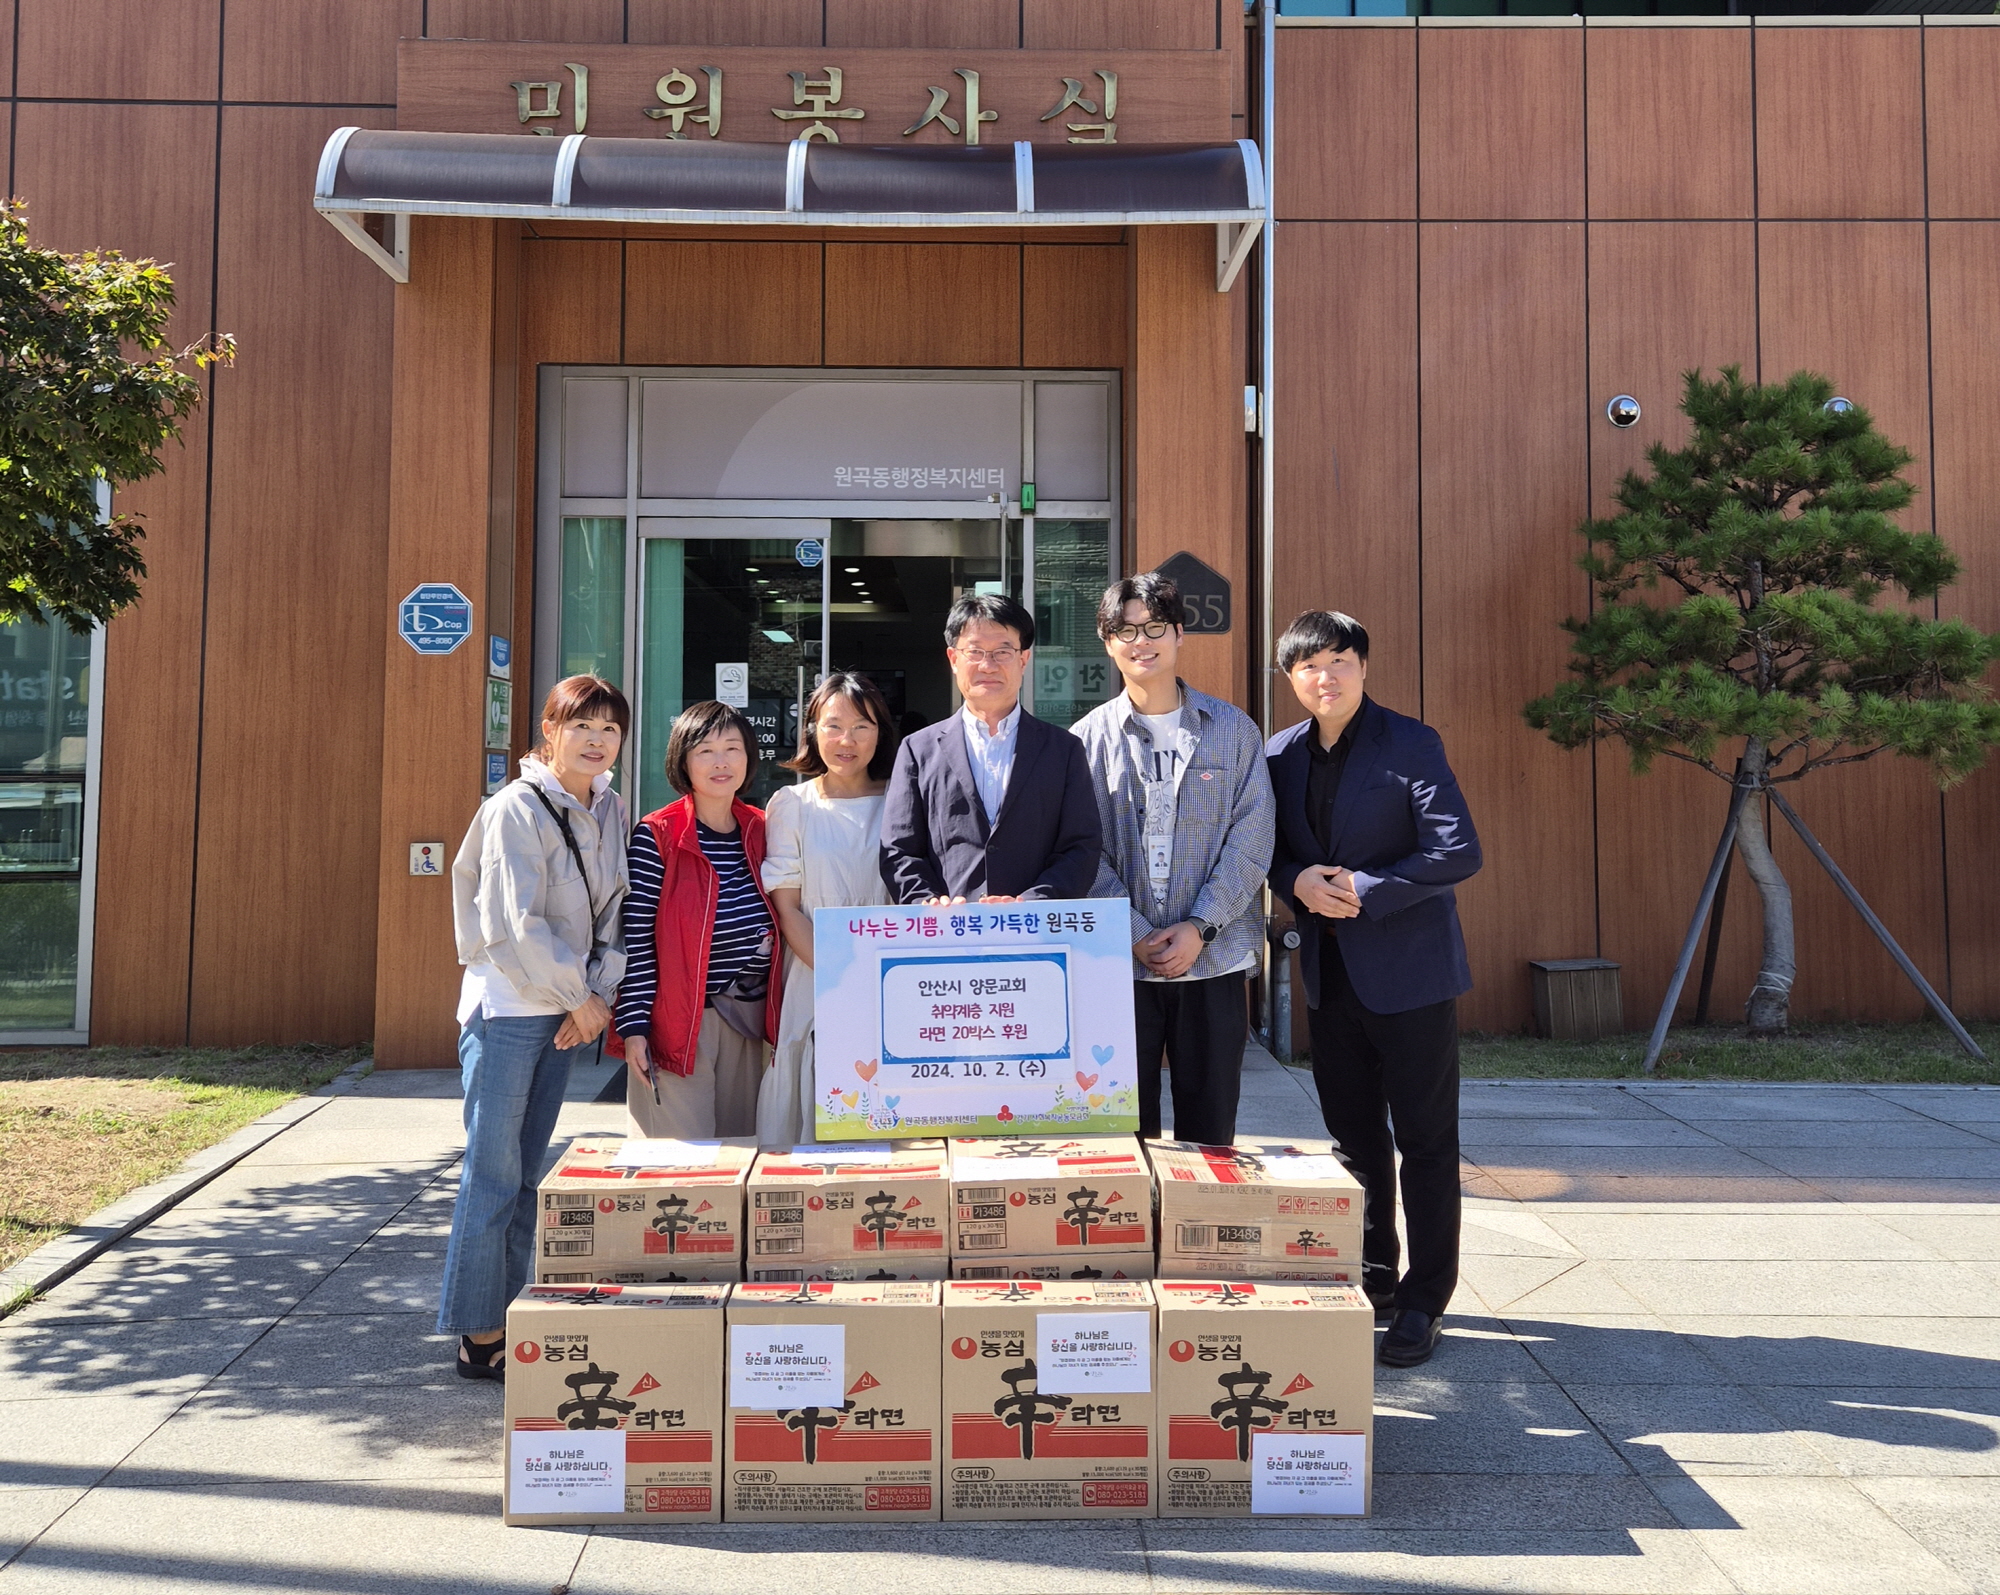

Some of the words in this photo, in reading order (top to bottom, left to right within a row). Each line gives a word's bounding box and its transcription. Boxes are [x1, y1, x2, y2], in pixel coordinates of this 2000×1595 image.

[834, 466, 1004, 489] 원곡동행정복지센터
[849, 917, 900, 938] 나누는
[905, 916, 944, 938] 기쁨,
[950, 914, 983, 936] 행복
[990, 912, 1041, 934] 가득한
[1046, 911, 1097, 934] 원곡동
[918, 979, 962, 997] 안산시
[969, 977, 1027, 995] 양문교회
[931, 1003, 983, 1020] 취약계층
[989, 1002, 1015, 1018] 지원
[919, 1026, 946, 1042] 라면
[952, 1025, 996, 1041] 20박스
[1002, 1024, 1028, 1040] 후원
[911, 1063, 954, 1079] 2024.
[963, 1062, 987, 1078] 10.
[996, 1062, 1010, 1077] 2.
[1018, 1059, 1047, 1078] (수)
[904, 1114, 978, 1126] 원곡동행정복지센터
[825, 1197, 854, 1210] 농심
[1028, 1192, 1056, 1205] 농심
[617, 1199, 645, 1212] 농심
[975, 1205, 1005, 1217] 가3486
[563, 1213, 593, 1224] 가3486
[907, 1217, 936, 1229] 라면
[1109, 1212, 1138, 1224] 라면
[697, 1221, 727, 1233] 라면
[1220, 1229, 1260, 1240] 가3486
[1075, 1331, 1109, 1340] 하나님은
[544, 1344, 589, 1362] 농심
[769, 1344, 803, 1353] 하나님은
[980, 1340, 1024, 1357] 농심
[1052, 1343, 1077, 1352] 당신을
[1080, 1342, 1133, 1351] 사랑하십니다
[1198, 1344, 1242, 1361] 농심
[745, 1357, 771, 1365] 당신을
[774, 1356, 827, 1365] 사랑하십니다
[642, 1378, 652, 1388] 신
[862, 1376, 872, 1387] 신
[1295, 1378, 1305, 1388] 신
[635, 1409, 685, 1430] 라면
[855, 1408, 905, 1429] 라면
[1070, 1404, 1122, 1425] 라면
[1288, 1408, 1337, 1429] 라면
[549, 1450, 584, 1459] 하나님은
[1290, 1450, 1325, 1458] 하나님은
[525, 1462, 551, 1471] 당신을
[555, 1462, 608, 1471] 사랑하십니다
[1267, 1462, 1292, 1470] 당신을
[1296, 1461, 1348, 1470] 사랑하십니다
[739, 1473, 772, 1482] 주의사항
[957, 1470, 989, 1479] 주의사항
[1173, 1471, 1205, 1479] 주의사항
[1097, 1491, 1146, 1499] 080-023-5181
